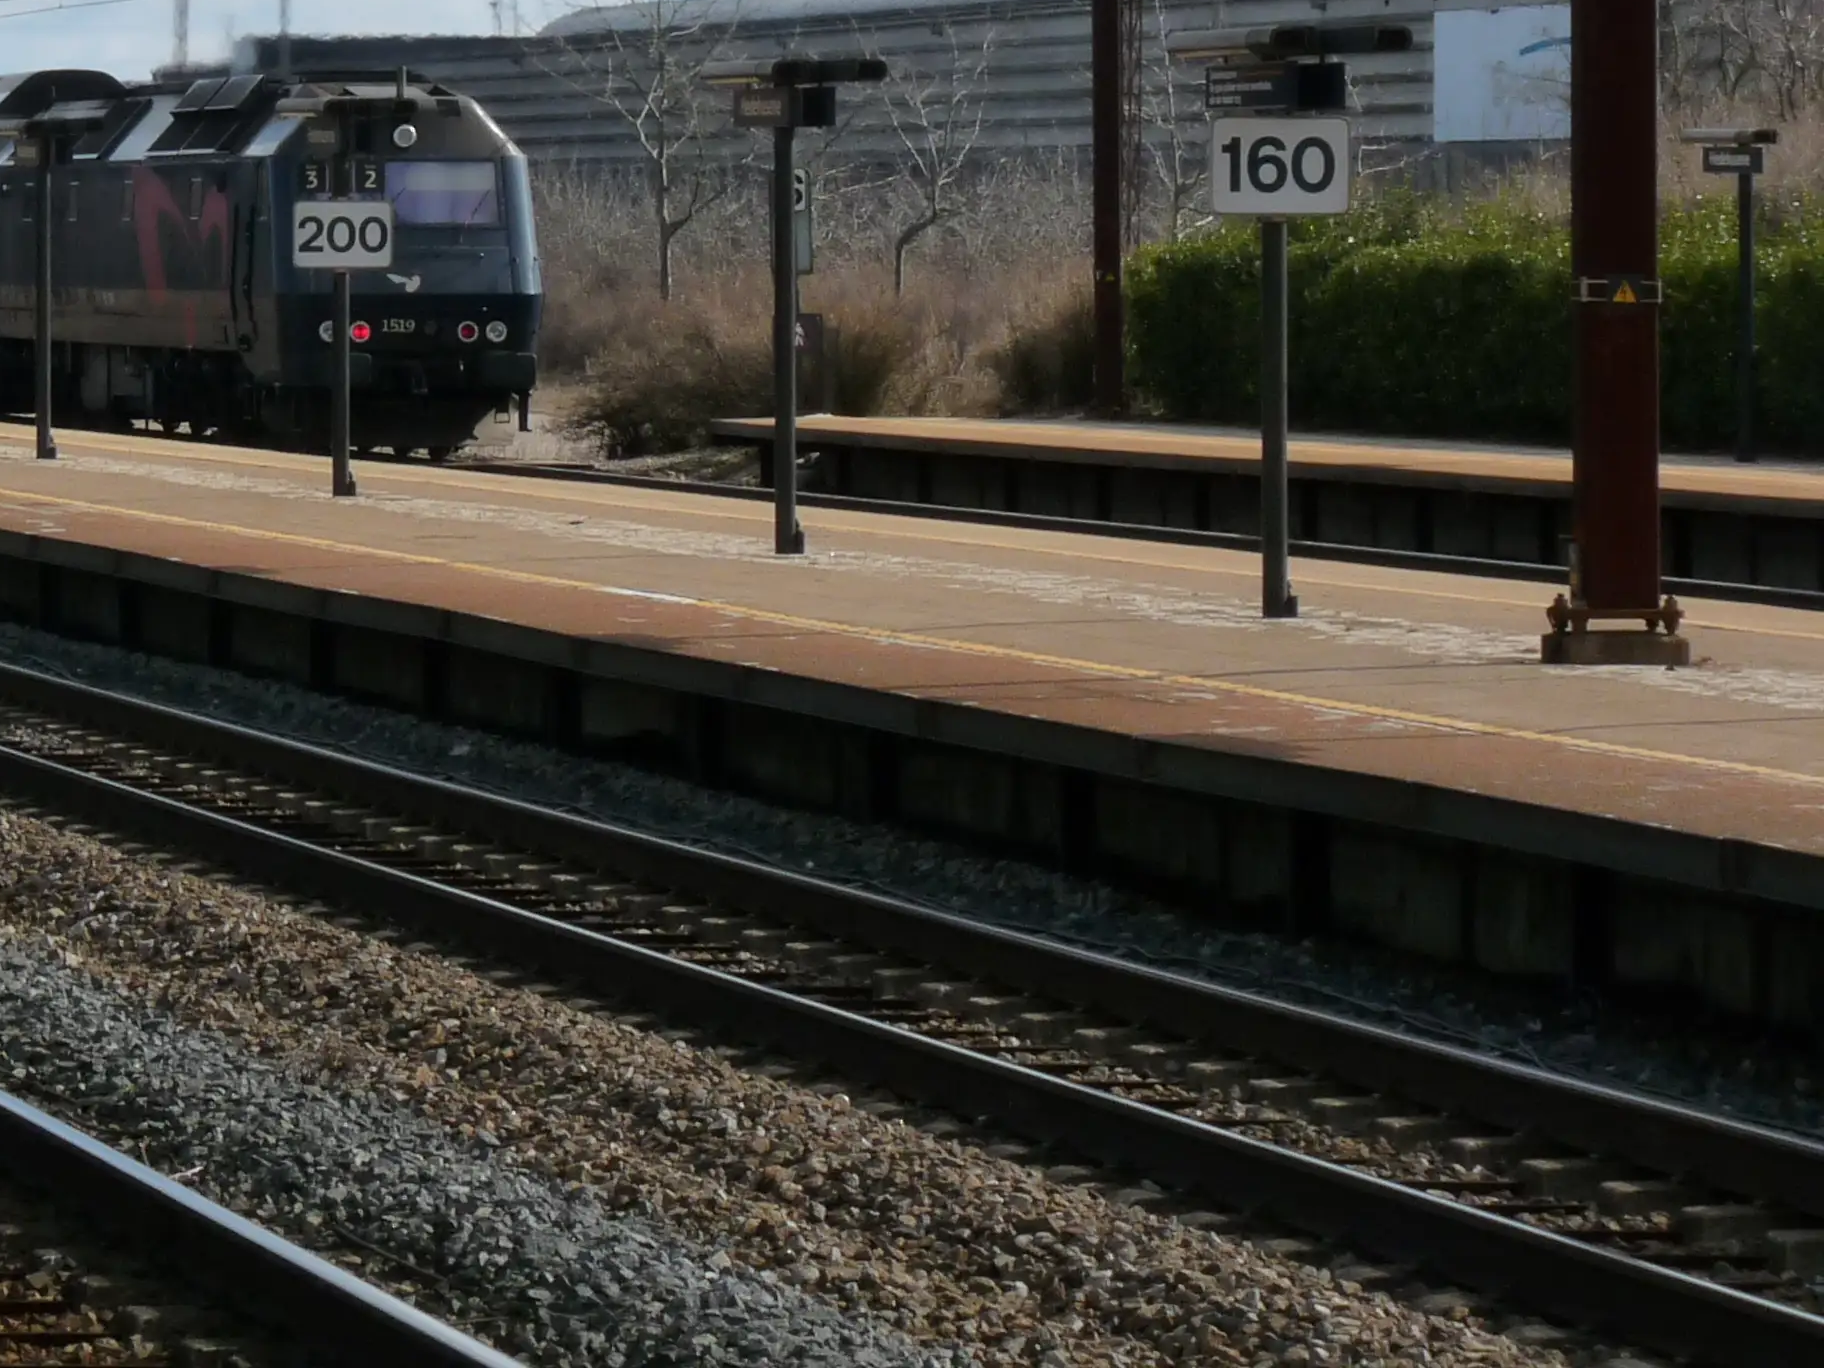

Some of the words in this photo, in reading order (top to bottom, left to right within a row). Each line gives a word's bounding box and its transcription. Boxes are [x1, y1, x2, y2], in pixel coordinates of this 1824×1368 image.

[1222, 136, 1335, 193] 160
[305, 170, 318, 189] 3
[364, 170, 377, 189] 2
[298, 216, 389, 253] 200
[382, 319, 416, 332] 1519
